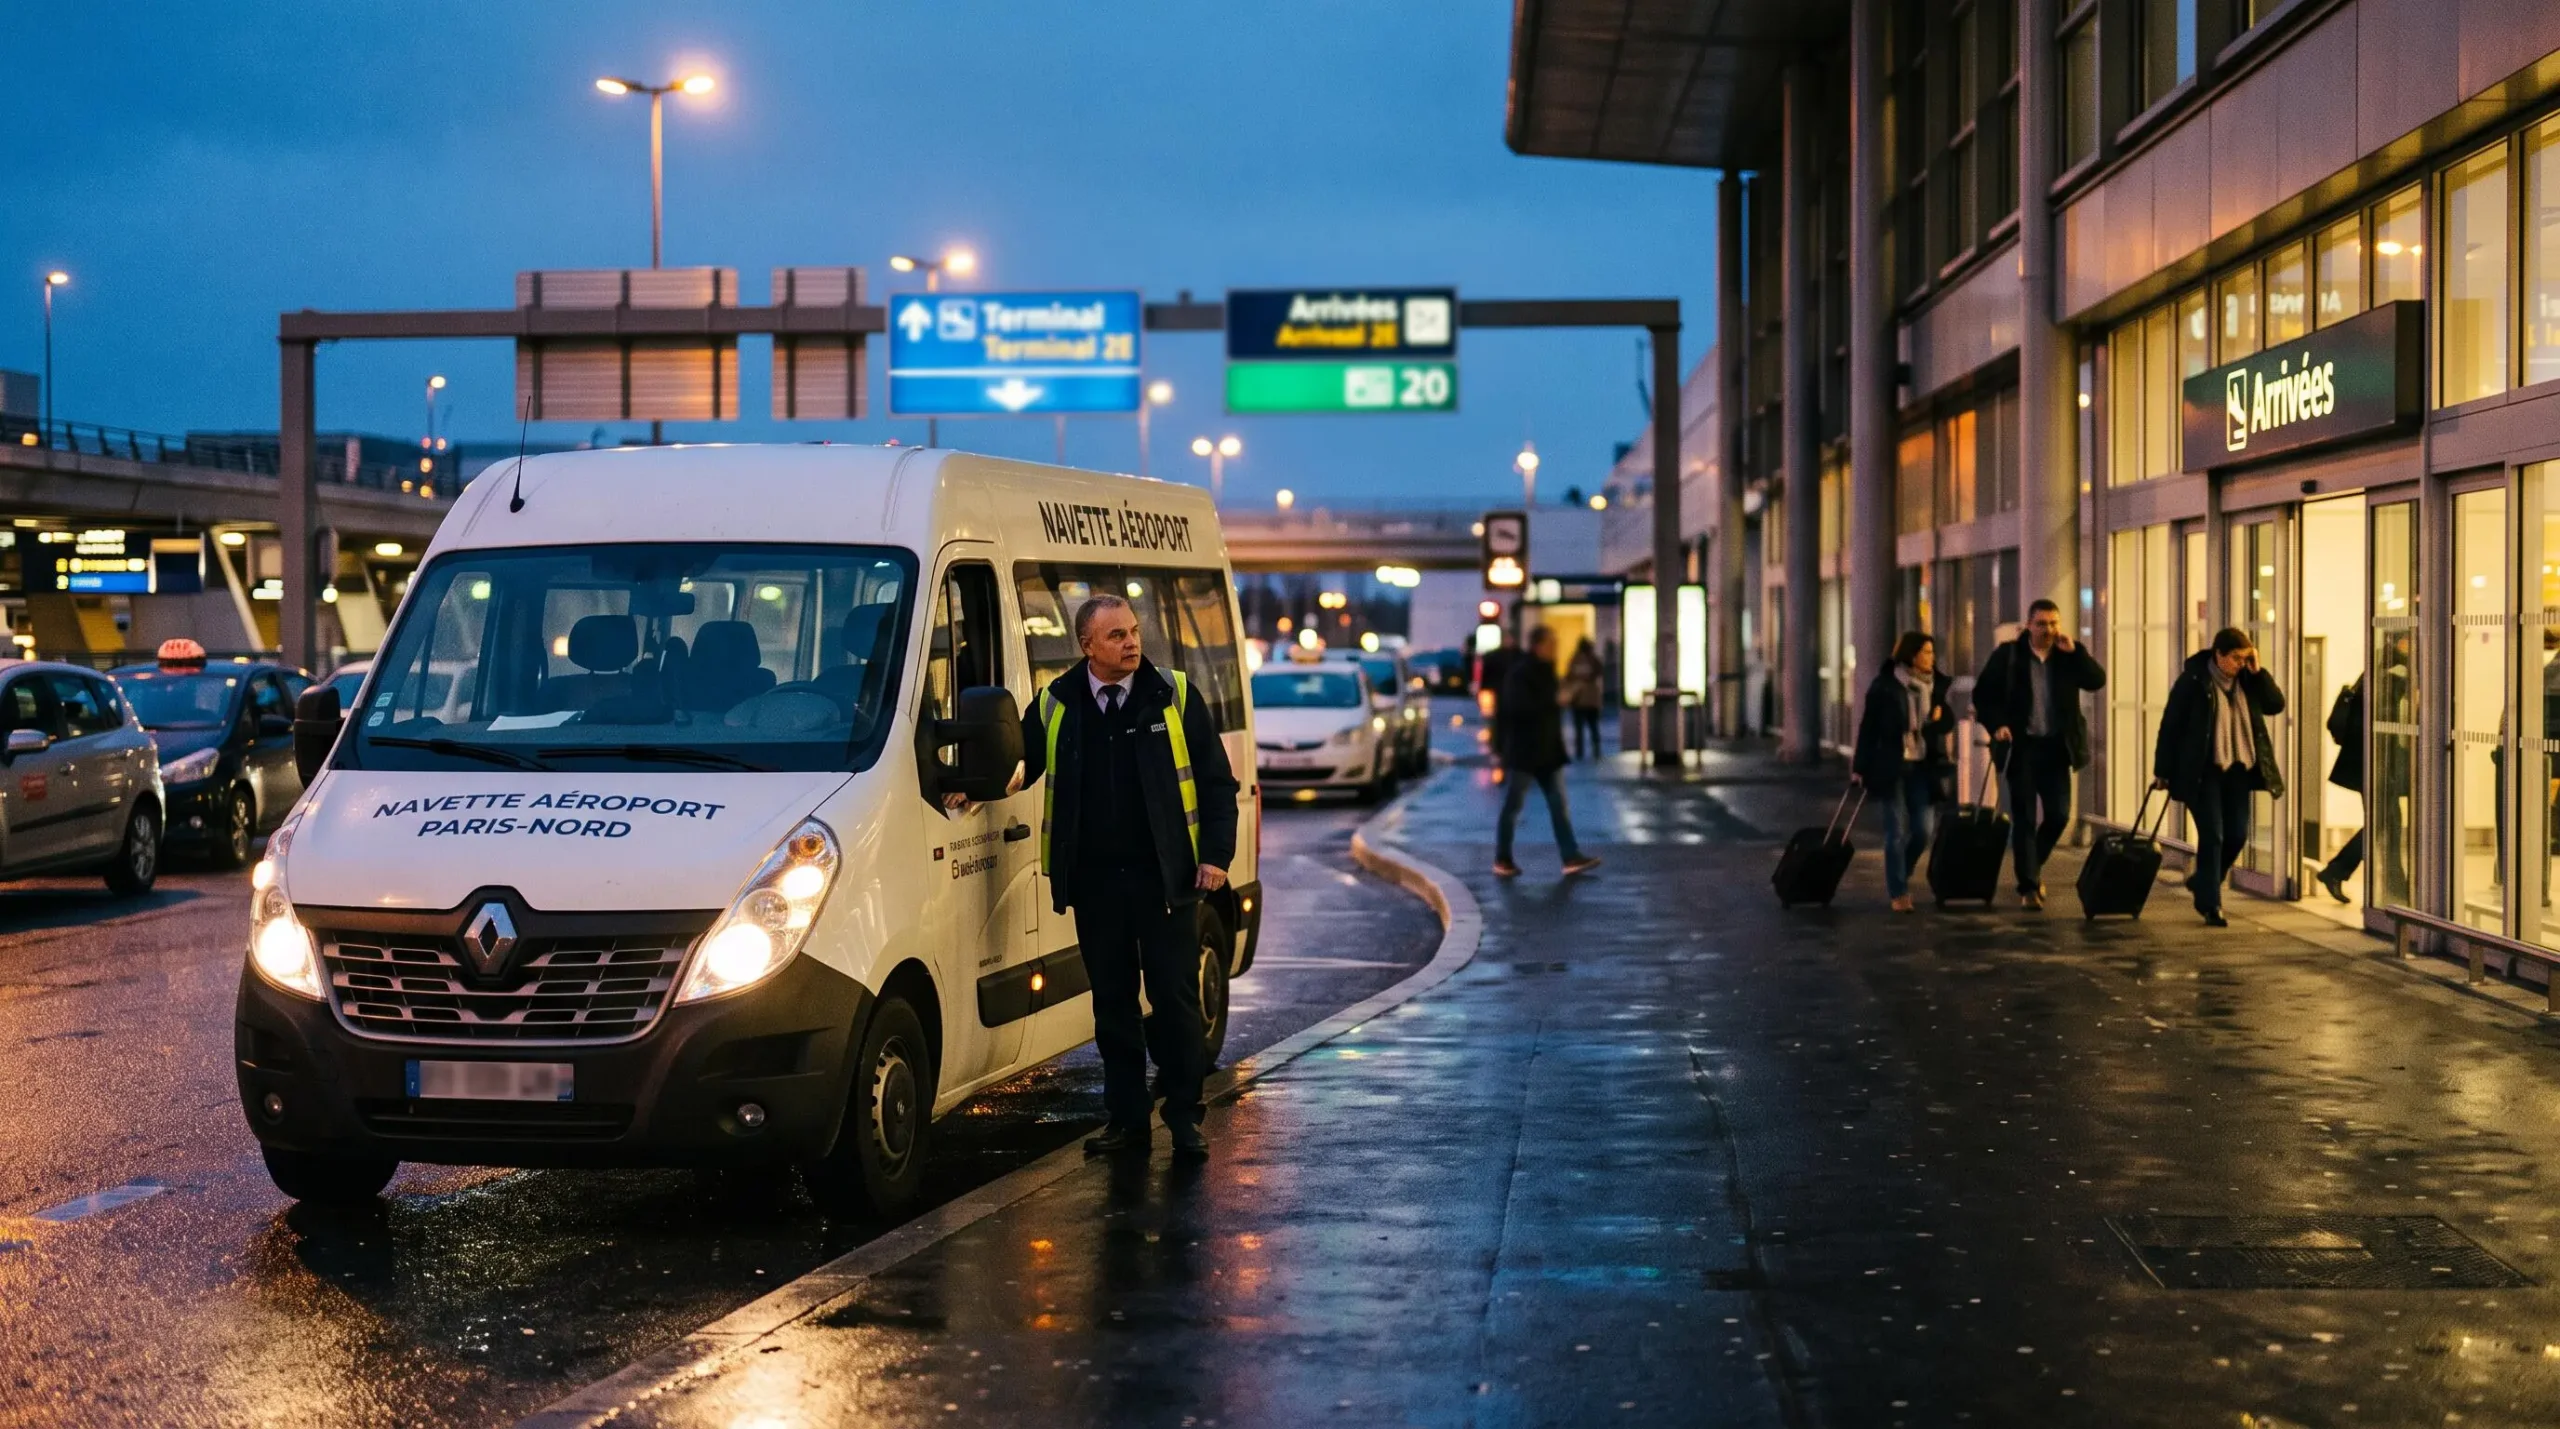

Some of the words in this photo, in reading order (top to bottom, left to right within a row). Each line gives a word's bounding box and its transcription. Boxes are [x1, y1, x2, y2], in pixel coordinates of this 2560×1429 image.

[981, 302, 1104, 331] Terminal
[984, 333, 1096, 361] Terminal
[1400, 368, 1449, 406] 20
[2250, 351, 2335, 434] Arrivées
[1038, 501, 1117, 547] NAVETTE
[1117, 500, 1193, 552] AÉROPORT
[373, 793, 525, 818] NAVETTE
[529, 790, 725, 820] AÉROPORT
[417, 818, 632, 838] PARIS-NORD
